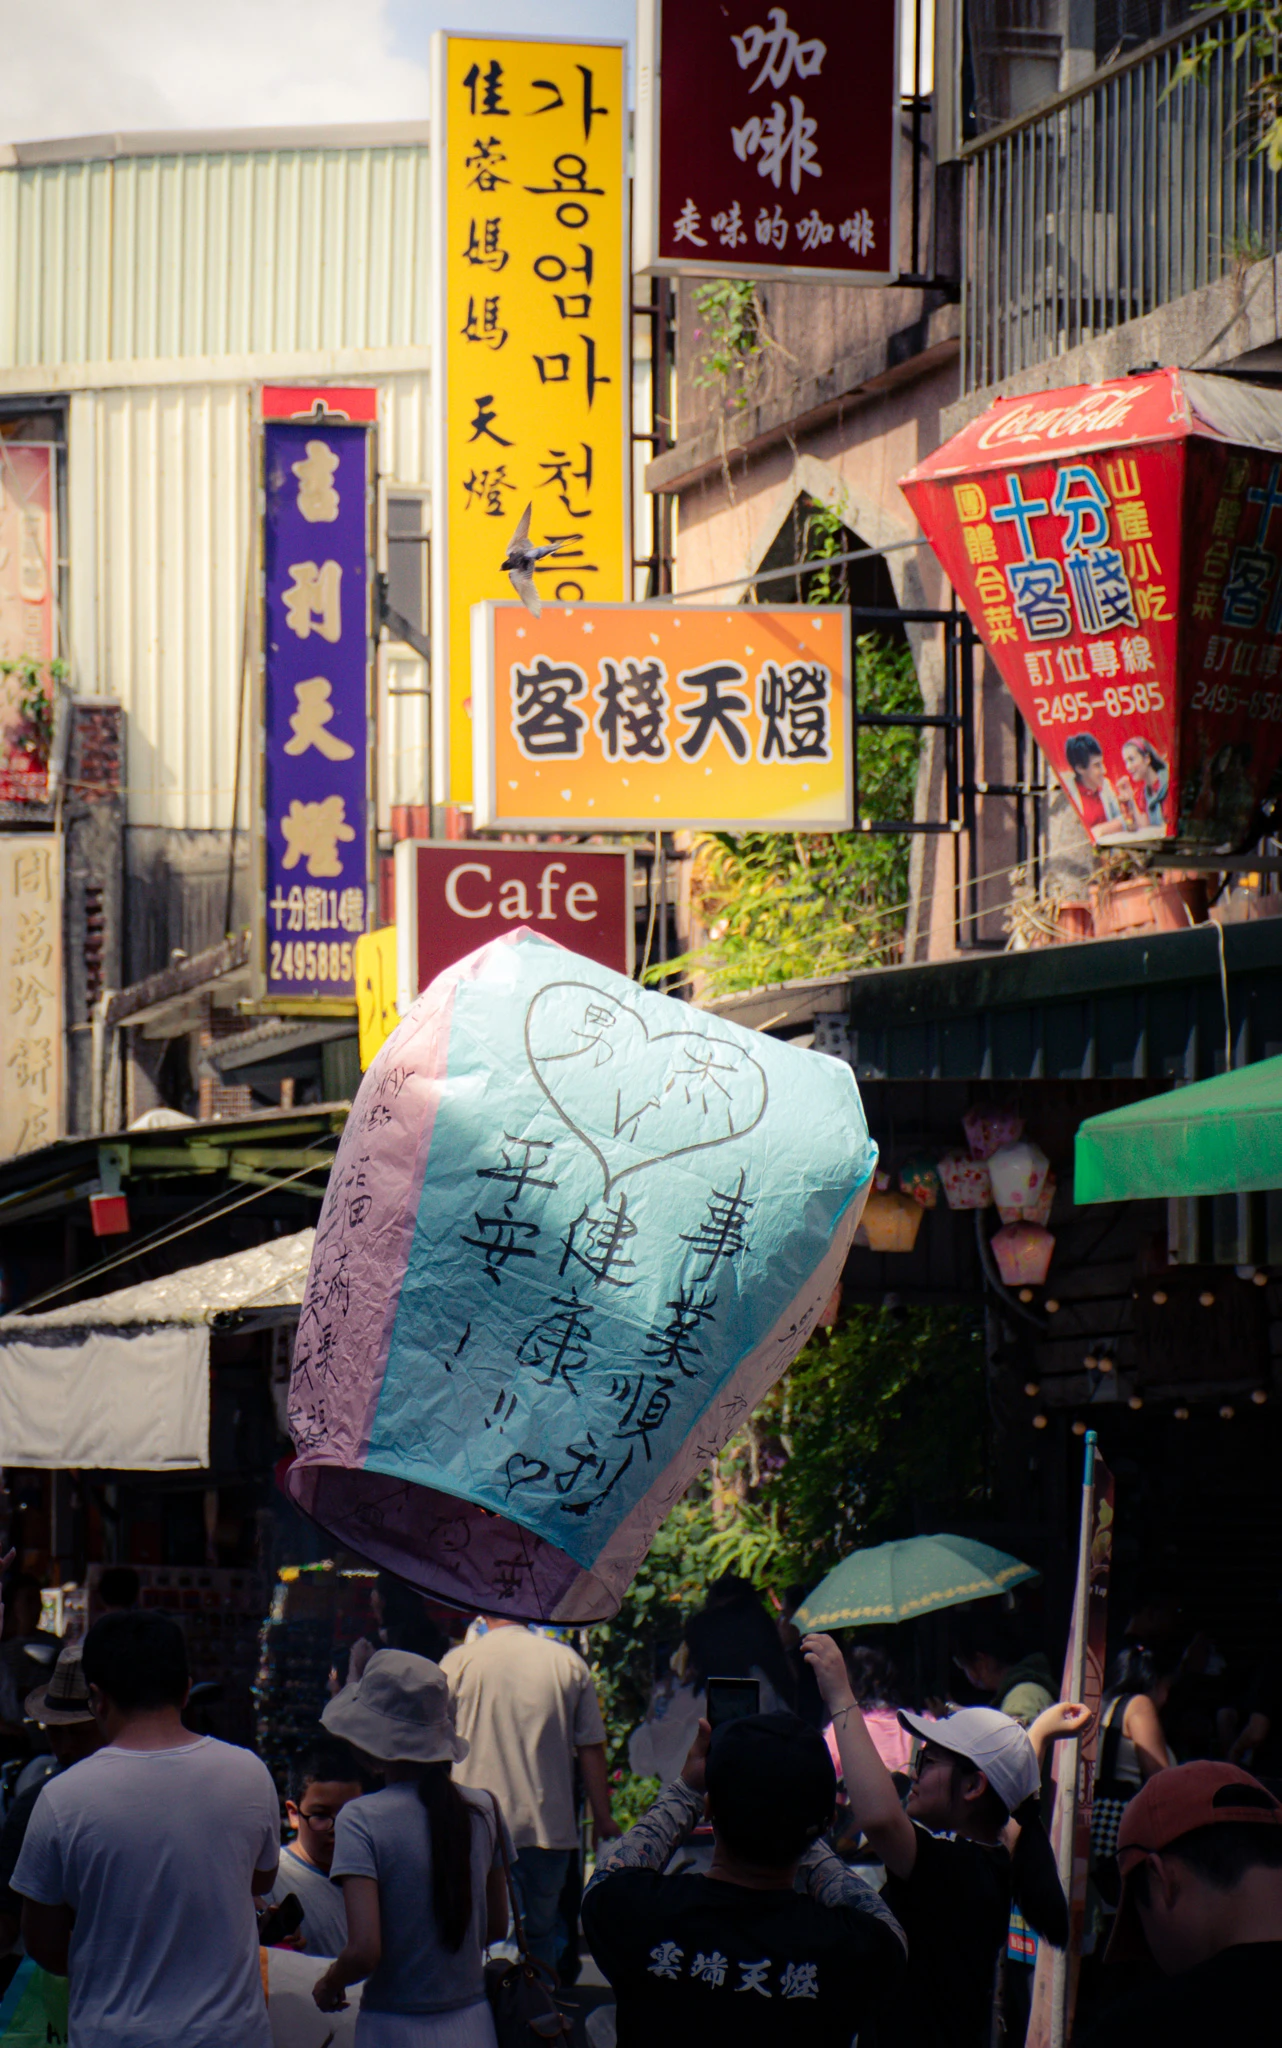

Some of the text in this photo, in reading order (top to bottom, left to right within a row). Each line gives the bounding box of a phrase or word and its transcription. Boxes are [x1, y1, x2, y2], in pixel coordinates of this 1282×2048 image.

[730, 7, 827, 195] 咖啡
[522, 64, 611, 413] 가용엄마
[673, 198, 876, 257] 走味的咖啡
[978, 384, 1155, 449] Coca-Cola
[990, 464, 1112, 558] 十分
[1106, 457, 1173, 622] 山產小吃
[1005, 548, 1139, 642] 客棧
[281, 440, 355, 877] 吉利天燈
[1024, 635, 1155, 687] 訂位專線
[1034, 681, 1165, 726] 2495-8585
[513, 657, 830, 761] 客棧天燈
[445, 862, 598, 921] Cafe
[647, 1942, 820, 1999] 雲端天燈
